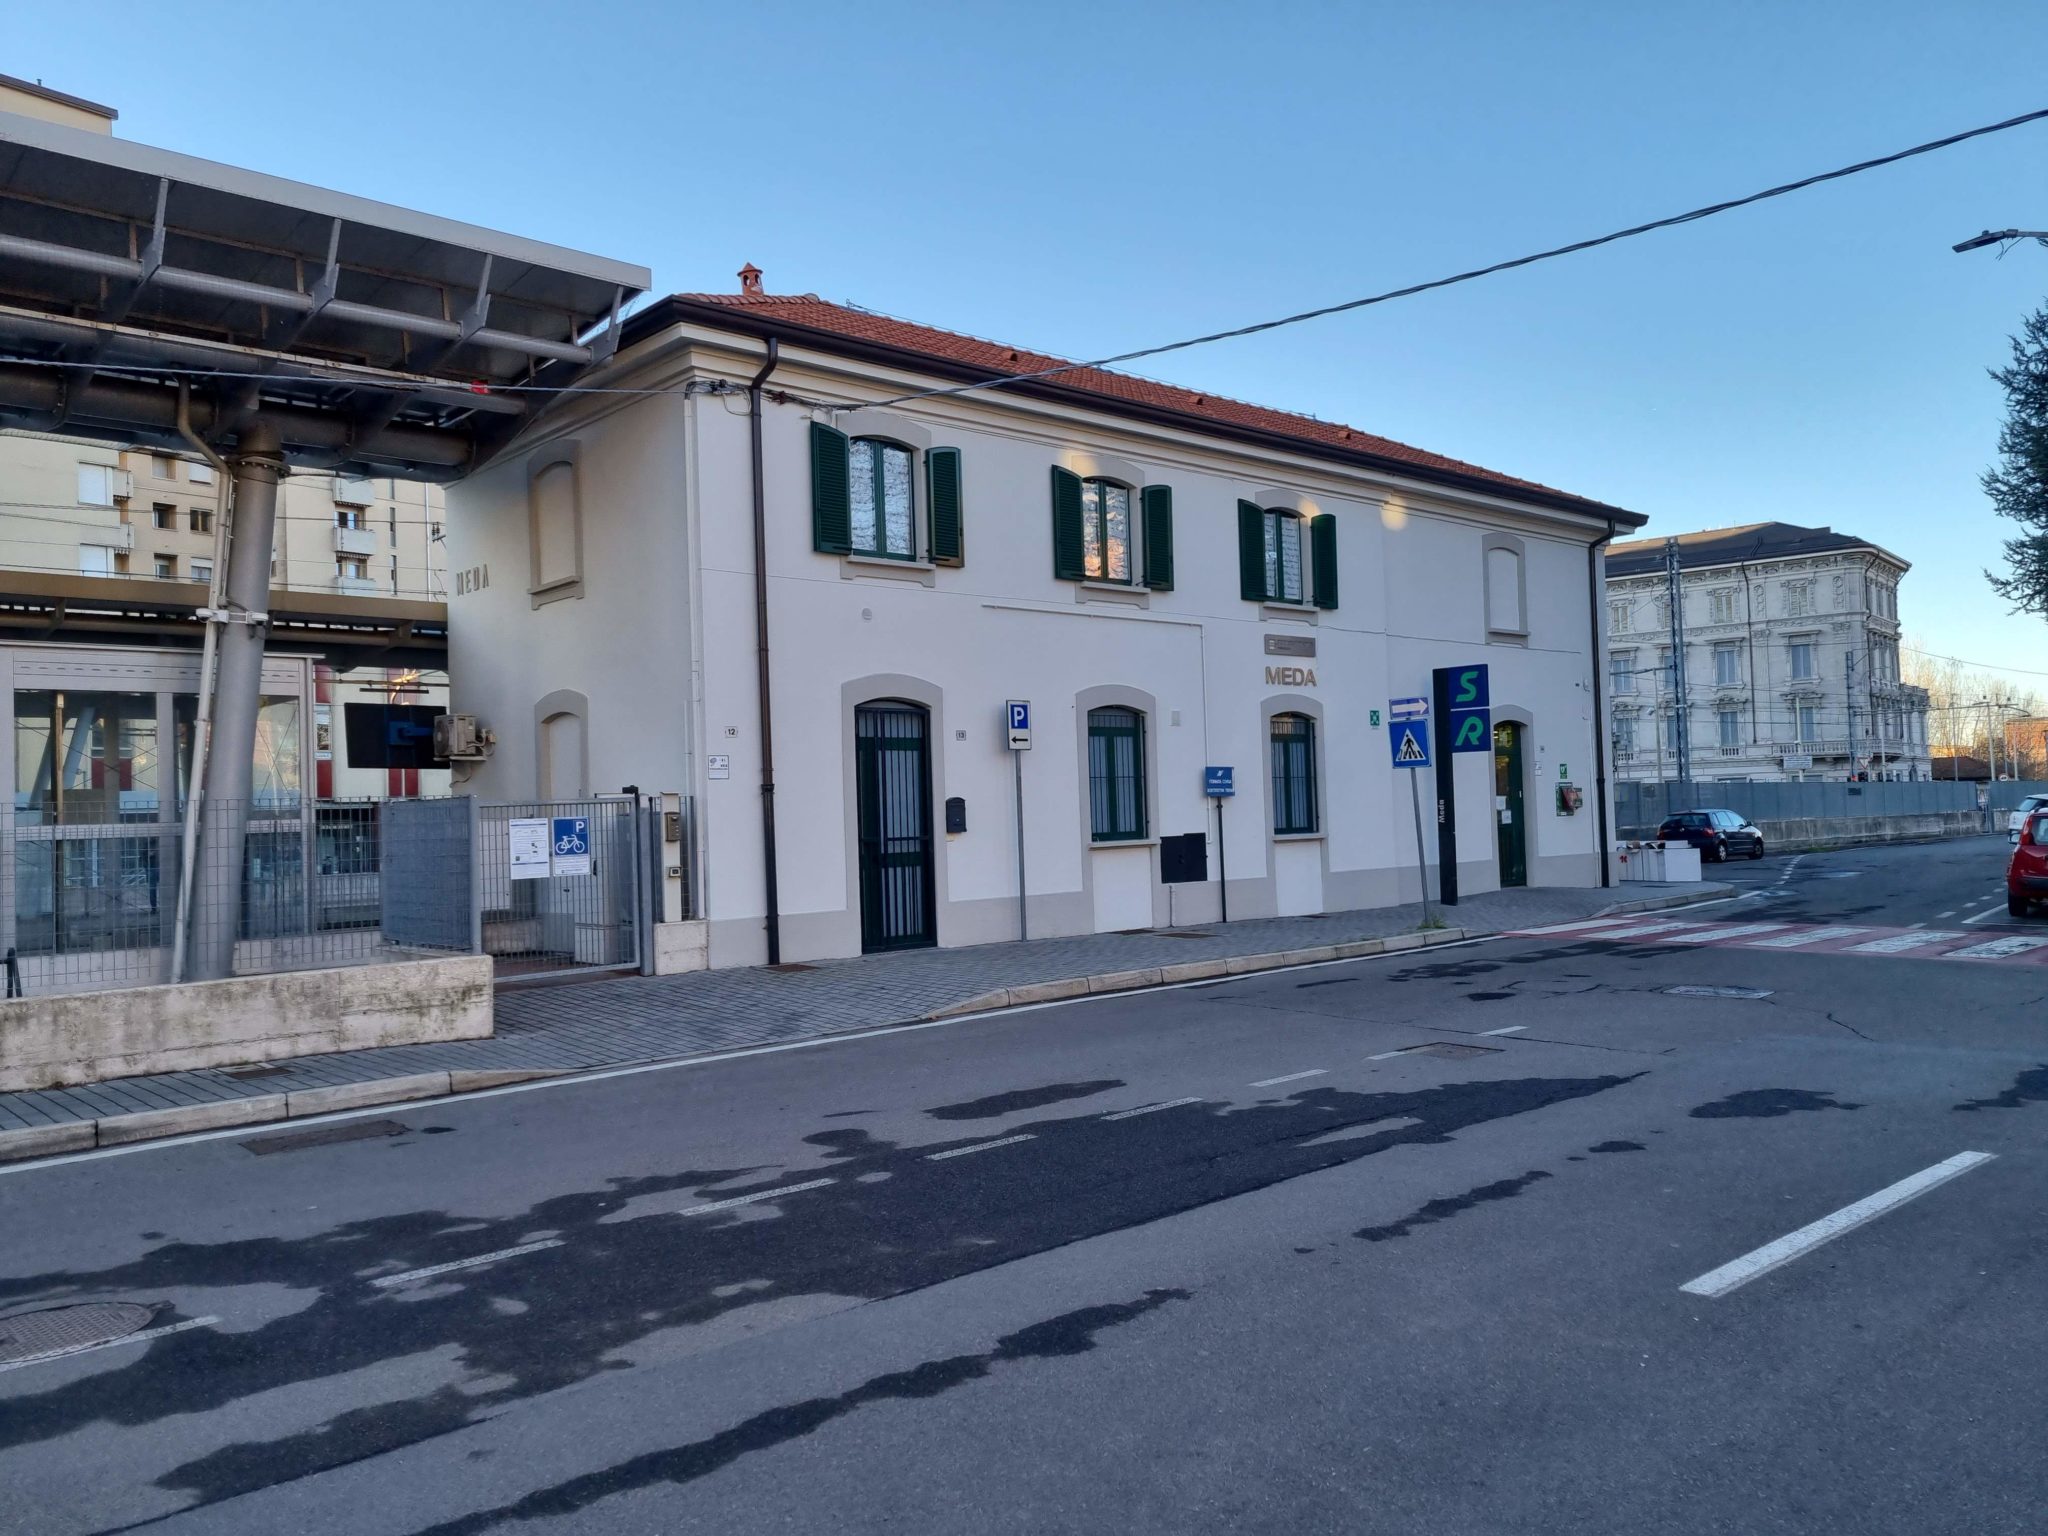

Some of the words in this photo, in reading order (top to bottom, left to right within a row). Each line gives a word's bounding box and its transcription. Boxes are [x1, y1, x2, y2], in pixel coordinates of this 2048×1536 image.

[456, 563, 489, 597] MEDA
[1265, 666, 1317, 687] MEDA
[1456, 671, 1479, 702] S
[1013, 706, 1025, 727] P
[727, 728, 736, 736] 12
[1455, 716, 1484, 746] R
[575, 821, 585, 833] P
